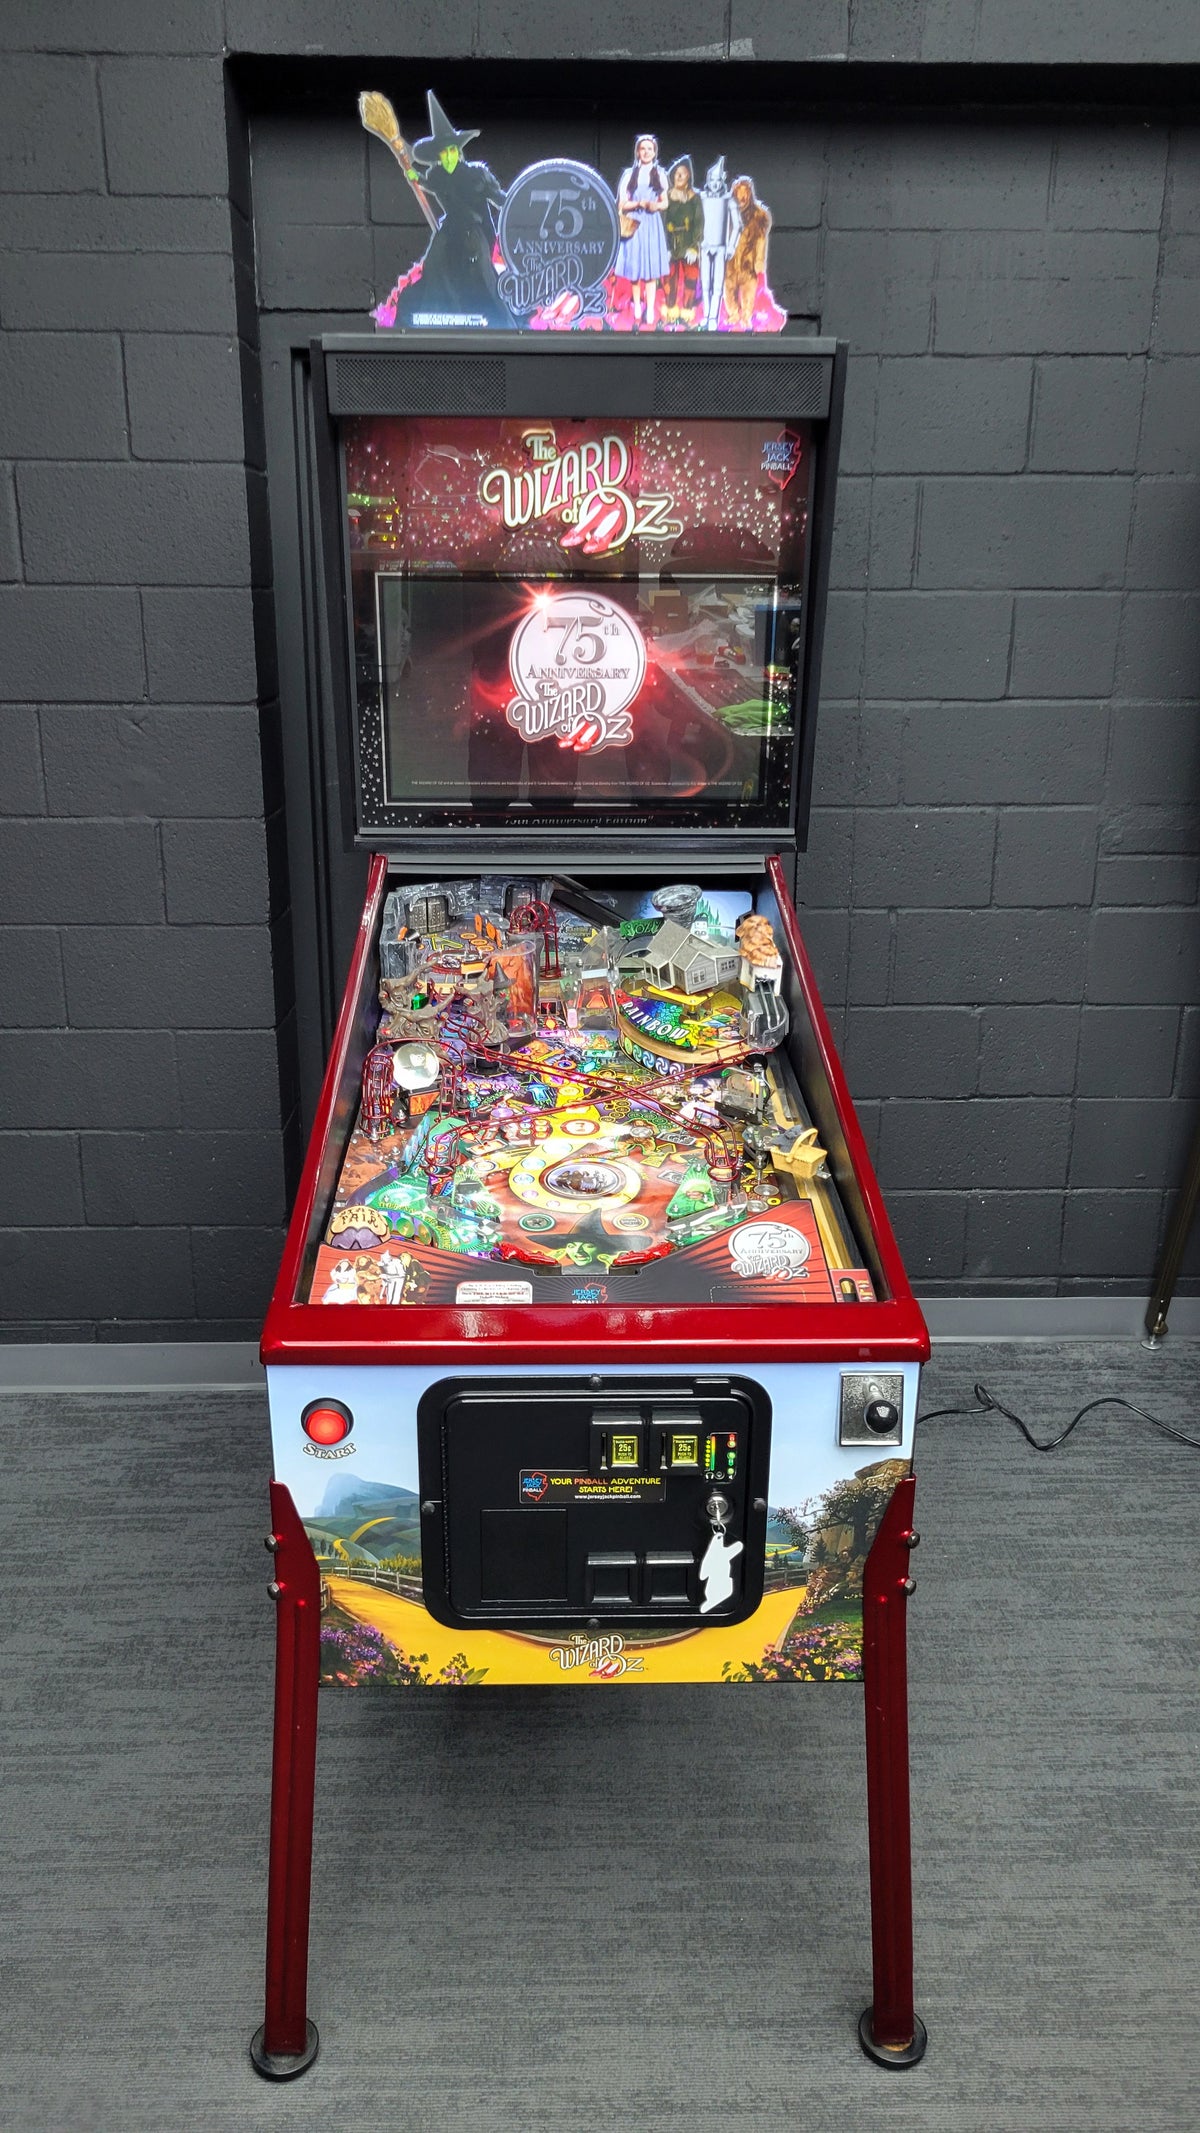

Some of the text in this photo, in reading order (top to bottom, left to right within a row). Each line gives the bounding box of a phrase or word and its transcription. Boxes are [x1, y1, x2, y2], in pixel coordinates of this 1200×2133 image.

[529, 189, 596, 239] 75th
[513, 238, 605, 254] ANNIVERSARY
[504, 257, 580, 308] WIZARD
[526, 435, 557, 460] The
[762, 441, 794, 453] JERSEY
[764, 453, 789, 464] JACK
[483, 436, 628, 528] WIZARD
[562, 497, 582, 523] of
[543, 616, 620, 665] 75th
[525, 664, 631, 679] ANNIVERSARY
[539, 683, 558, 697] The
[512, 683, 601, 735] WIZARD
[561, 717, 575, 733] of
[622, 1001, 690, 1040] RAINBOW
[341, 1213, 379, 1228] FAIR
[748, 1231, 794, 1249] 75th
[731, 1255, 789, 1278] WIZARD
[303, 1443, 357, 1459] START
[571, 1635, 587, 1645] The
[549, 1635, 623, 1670] WIZARD
[589, 1658, 601, 1668] of
